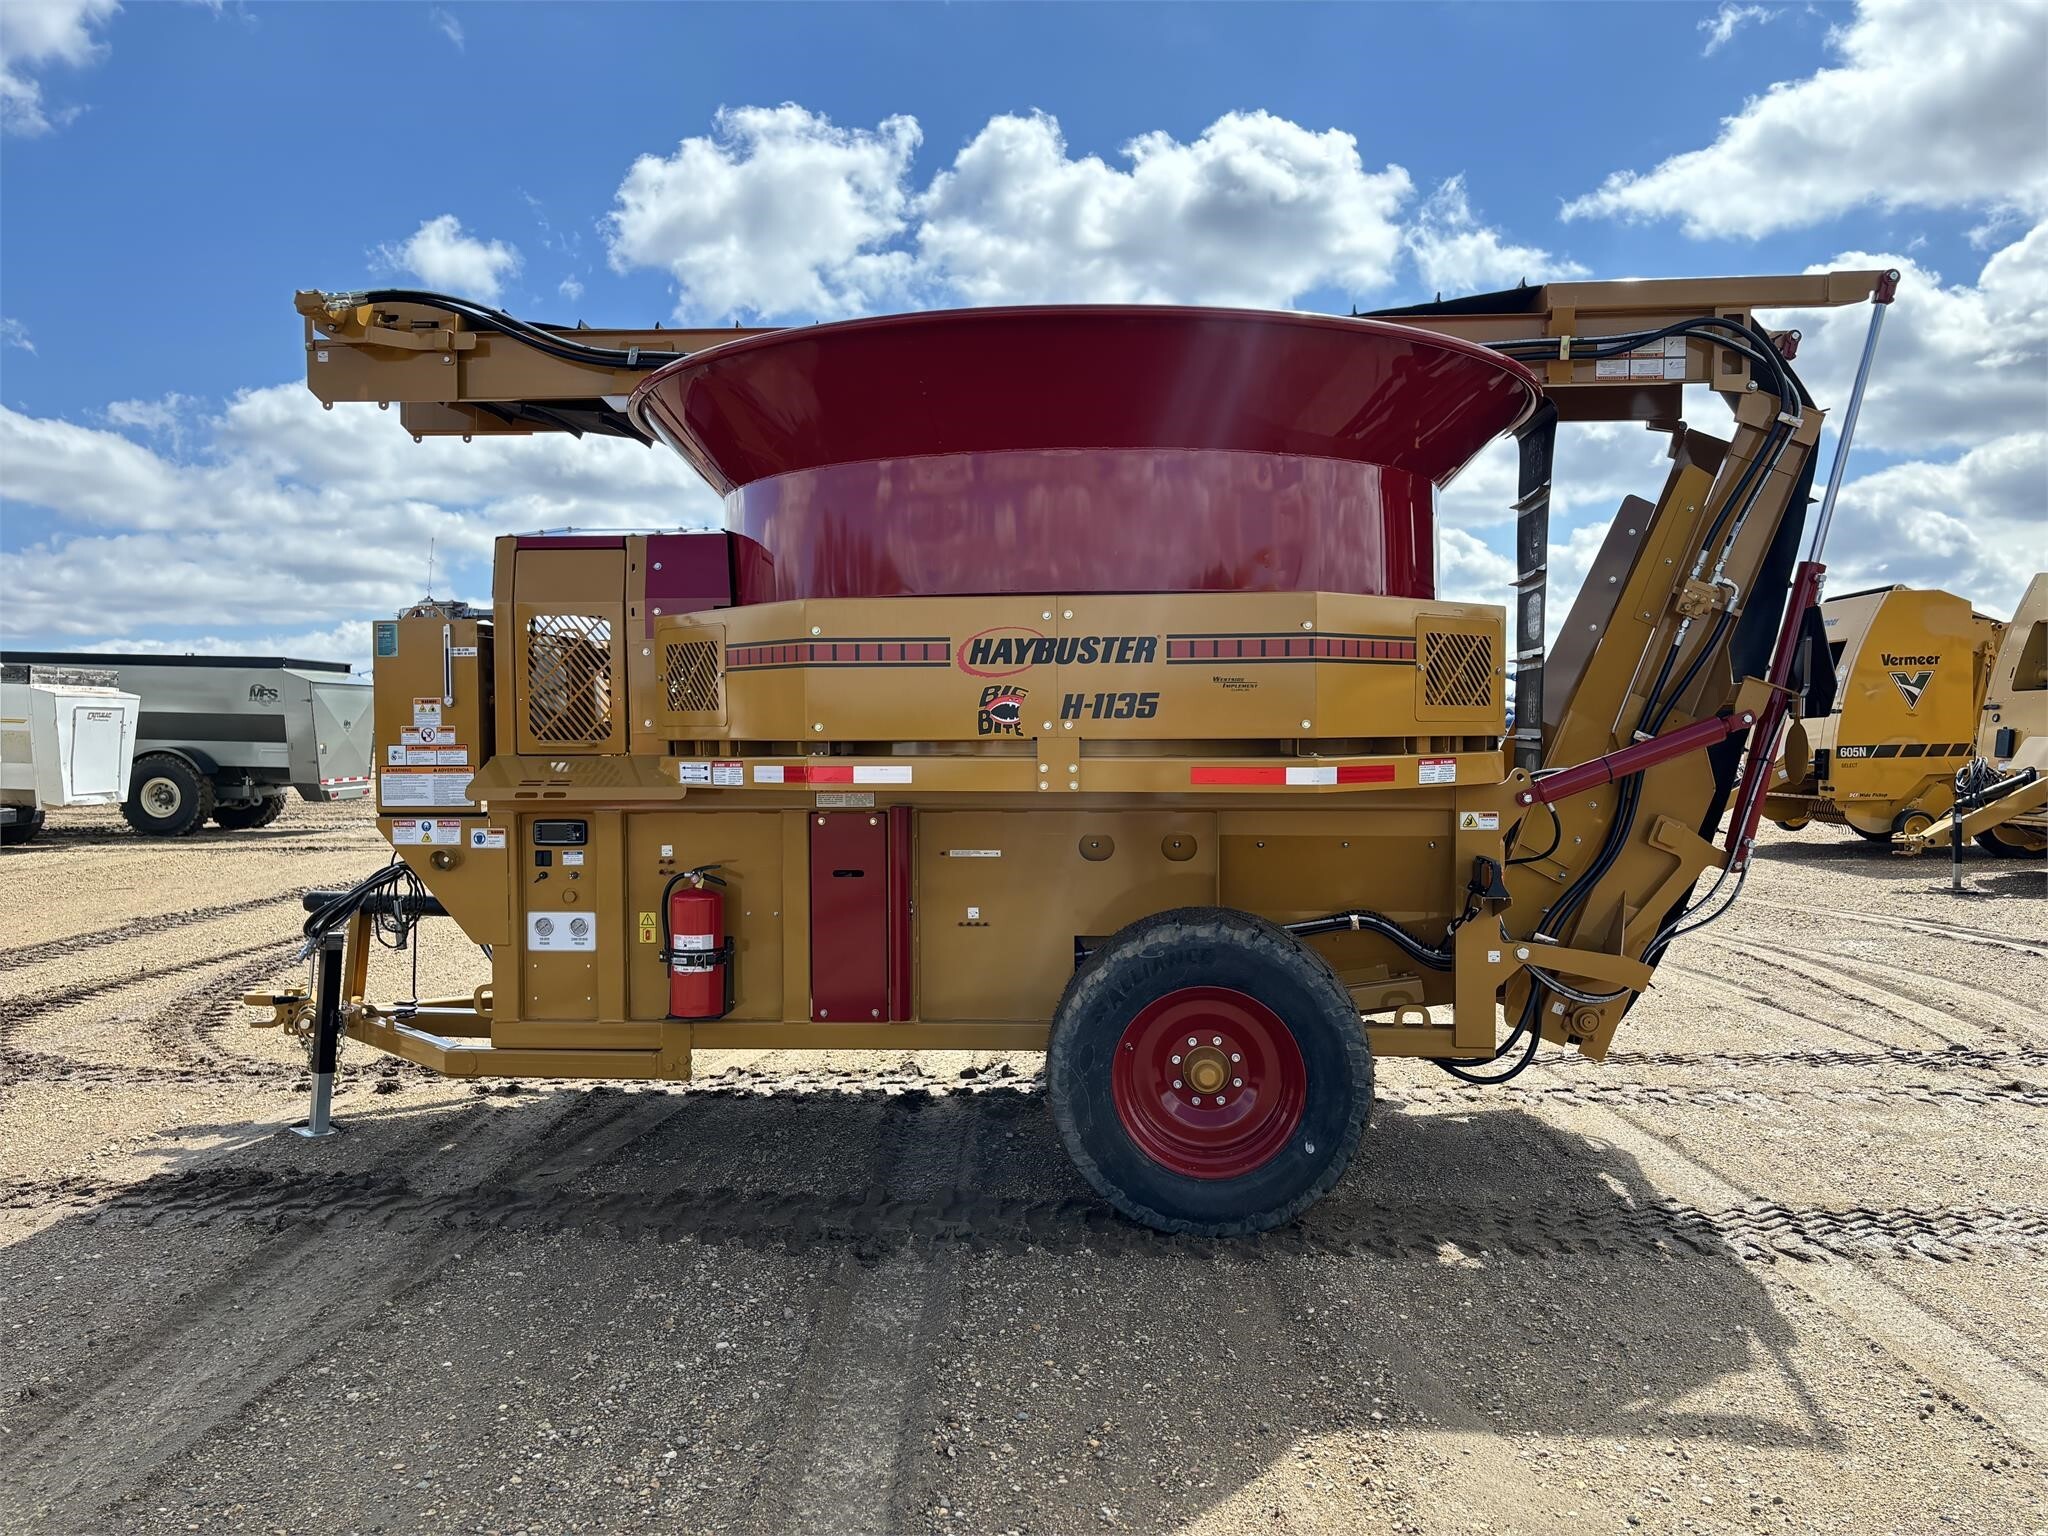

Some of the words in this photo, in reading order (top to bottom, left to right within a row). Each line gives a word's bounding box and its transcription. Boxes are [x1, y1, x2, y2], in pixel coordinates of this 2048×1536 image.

[969, 636, 1158, 665] HAYBUSTER
[1880, 653, 1941, 666] Vermeer
[979, 685, 1029, 708] BIG
[1060, 692, 1161, 720] H-1135
[977, 709, 1024, 737] BITE
[1840, 747, 1867, 757] 605N
